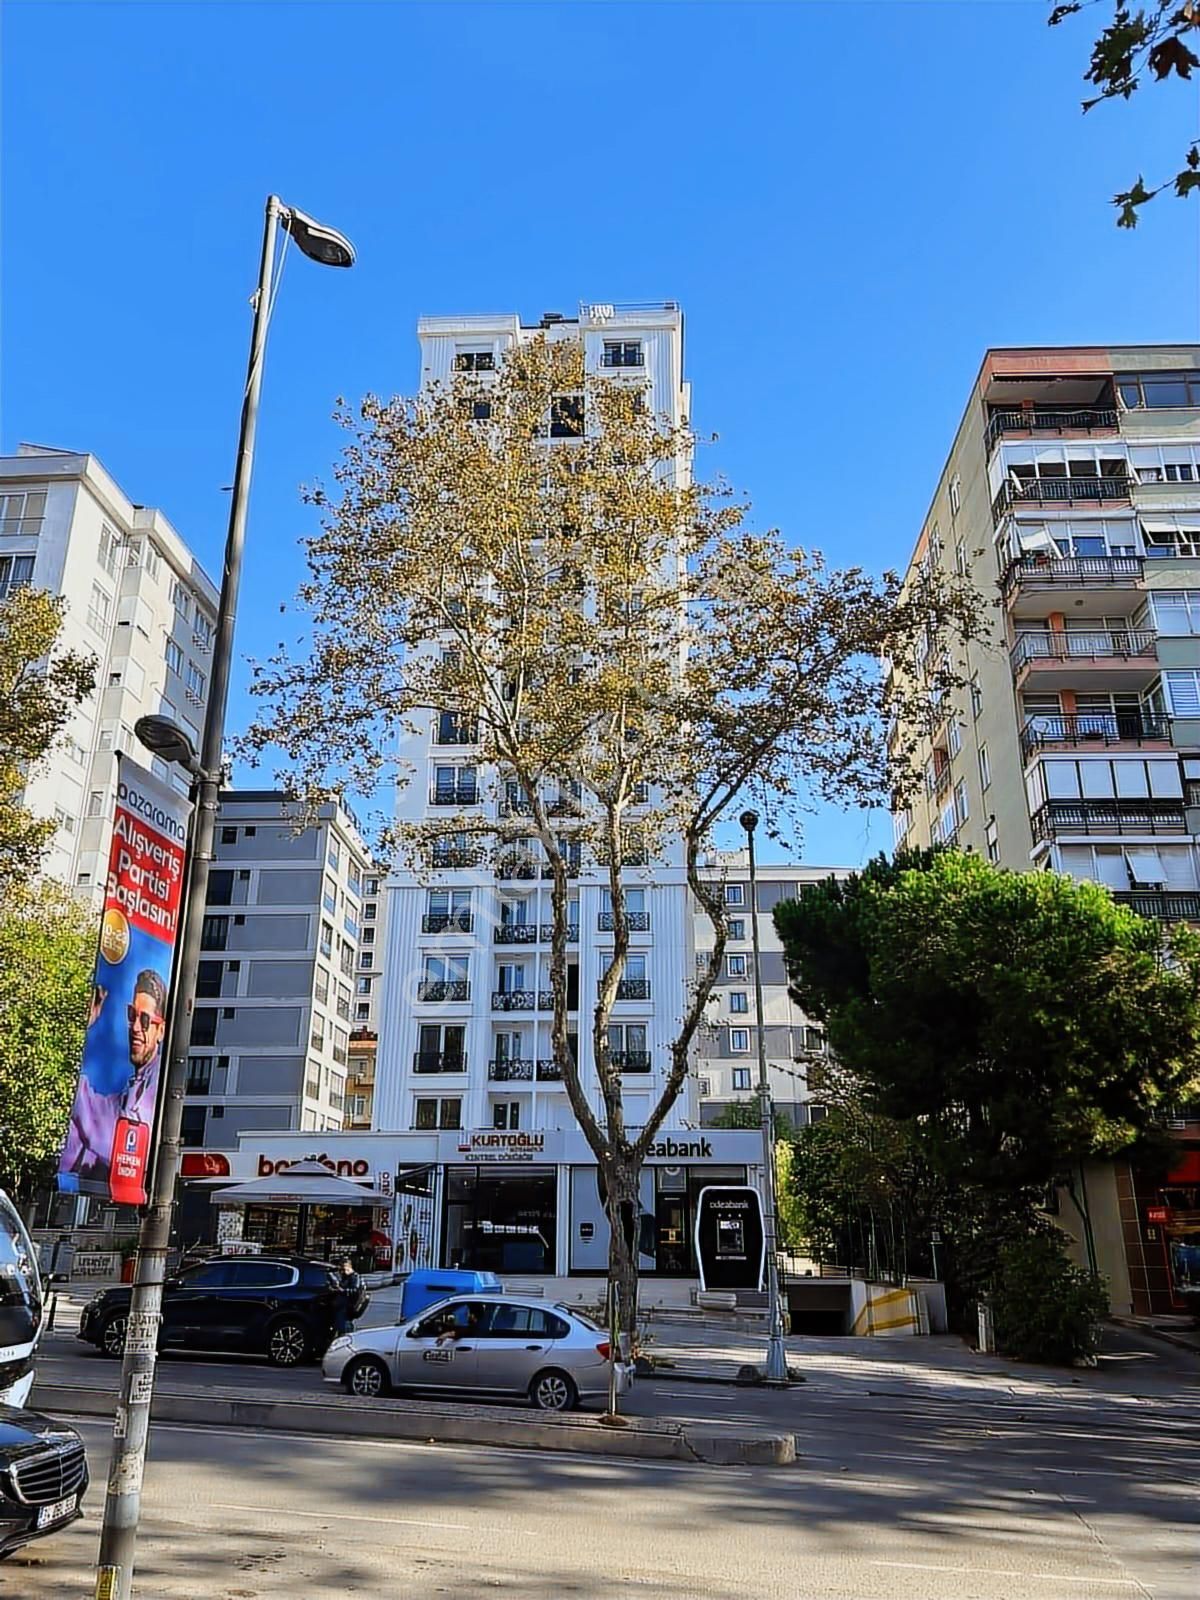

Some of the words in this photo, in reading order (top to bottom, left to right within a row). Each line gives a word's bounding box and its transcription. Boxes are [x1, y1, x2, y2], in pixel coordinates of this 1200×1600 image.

[114, 815, 180, 881] Alışveriş
[118, 848, 170, 902] Partisi
[107, 872, 176, 931] Başlasın!
[472, 1131, 544, 1147] KURTOĞLU
[645, 1136, 712, 1157] eabank
[709, 1199, 749, 1209] odeabank
